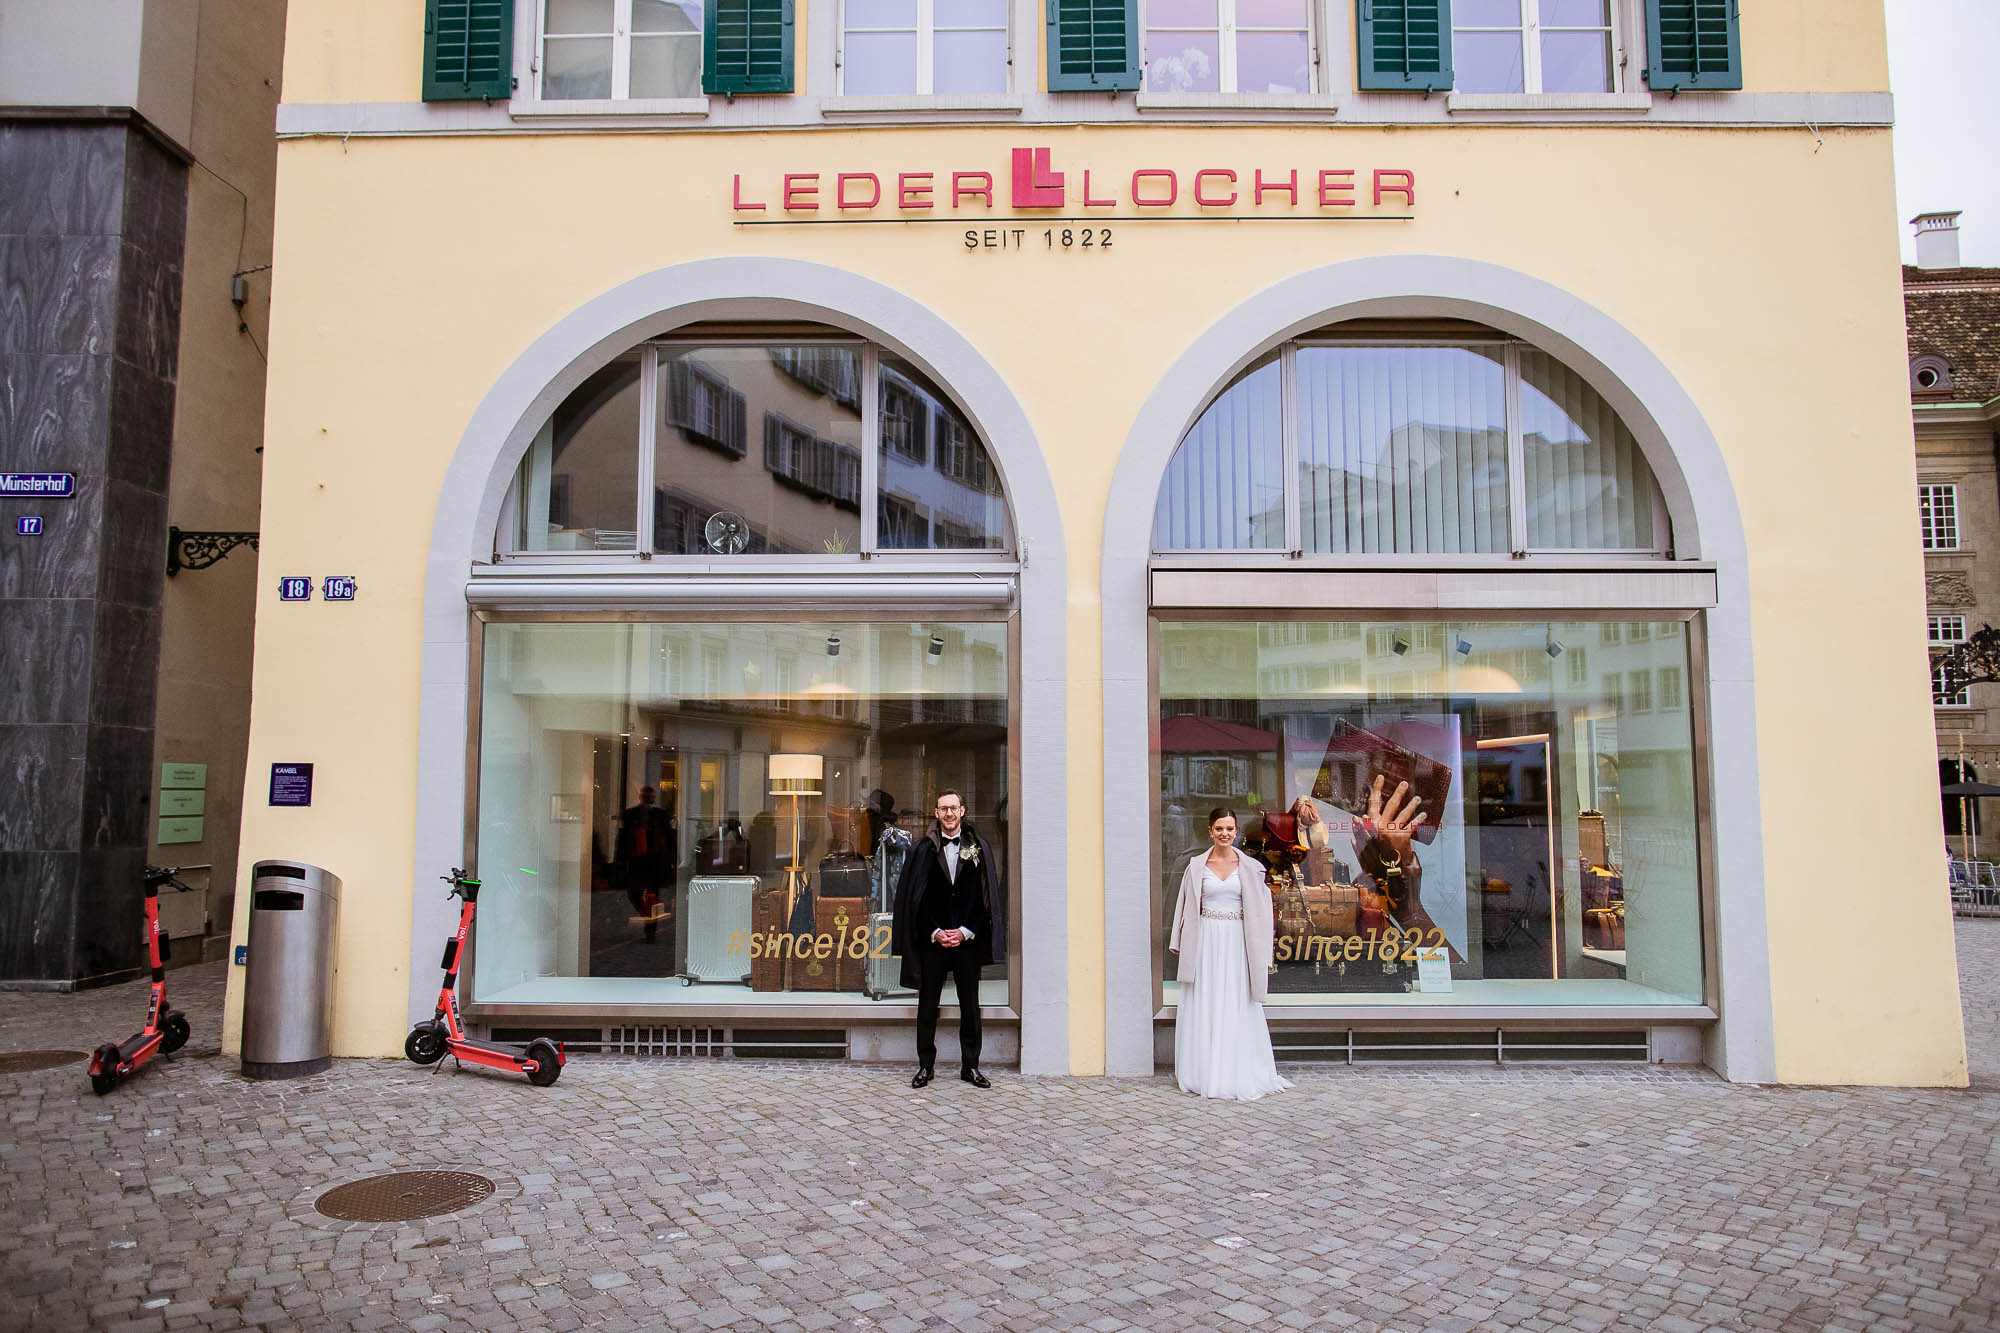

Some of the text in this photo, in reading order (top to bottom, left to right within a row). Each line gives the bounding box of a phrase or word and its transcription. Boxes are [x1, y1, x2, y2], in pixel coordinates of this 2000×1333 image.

[734, 171, 993, 210] LEDER
[1084, 169, 1415, 207] LOCHER
[965, 228, 1113, 248] SEIT 1822
[0, 475, 67, 491] Münsterhof
[23, 519, 38, 533] 17
[287, 580, 305, 597] 18
[327, 579, 351, 597] 19a
[725, 925, 903, 959] #since182
[1274, 927, 1446, 961] since1822
